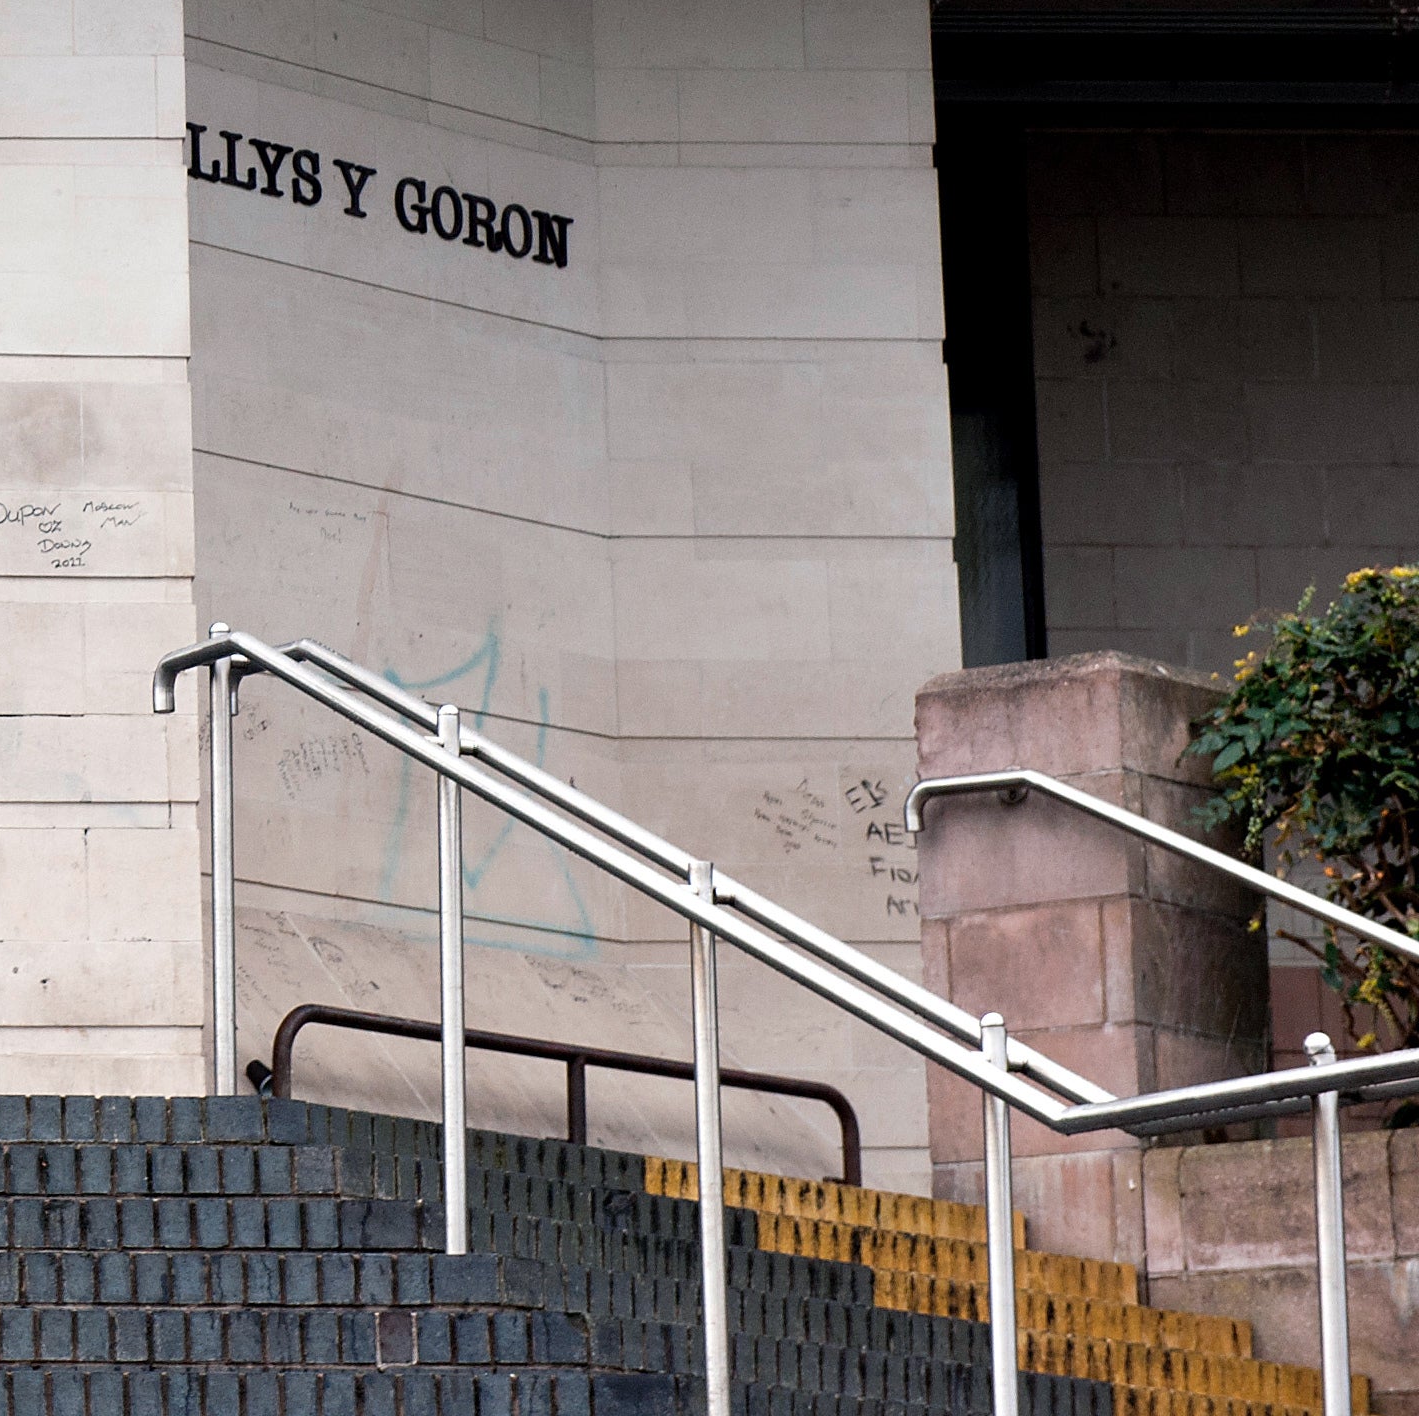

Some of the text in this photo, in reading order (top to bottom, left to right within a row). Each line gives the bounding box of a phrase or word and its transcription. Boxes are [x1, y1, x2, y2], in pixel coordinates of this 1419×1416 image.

[185, 121, 574, 268] LLYS Y GORON
